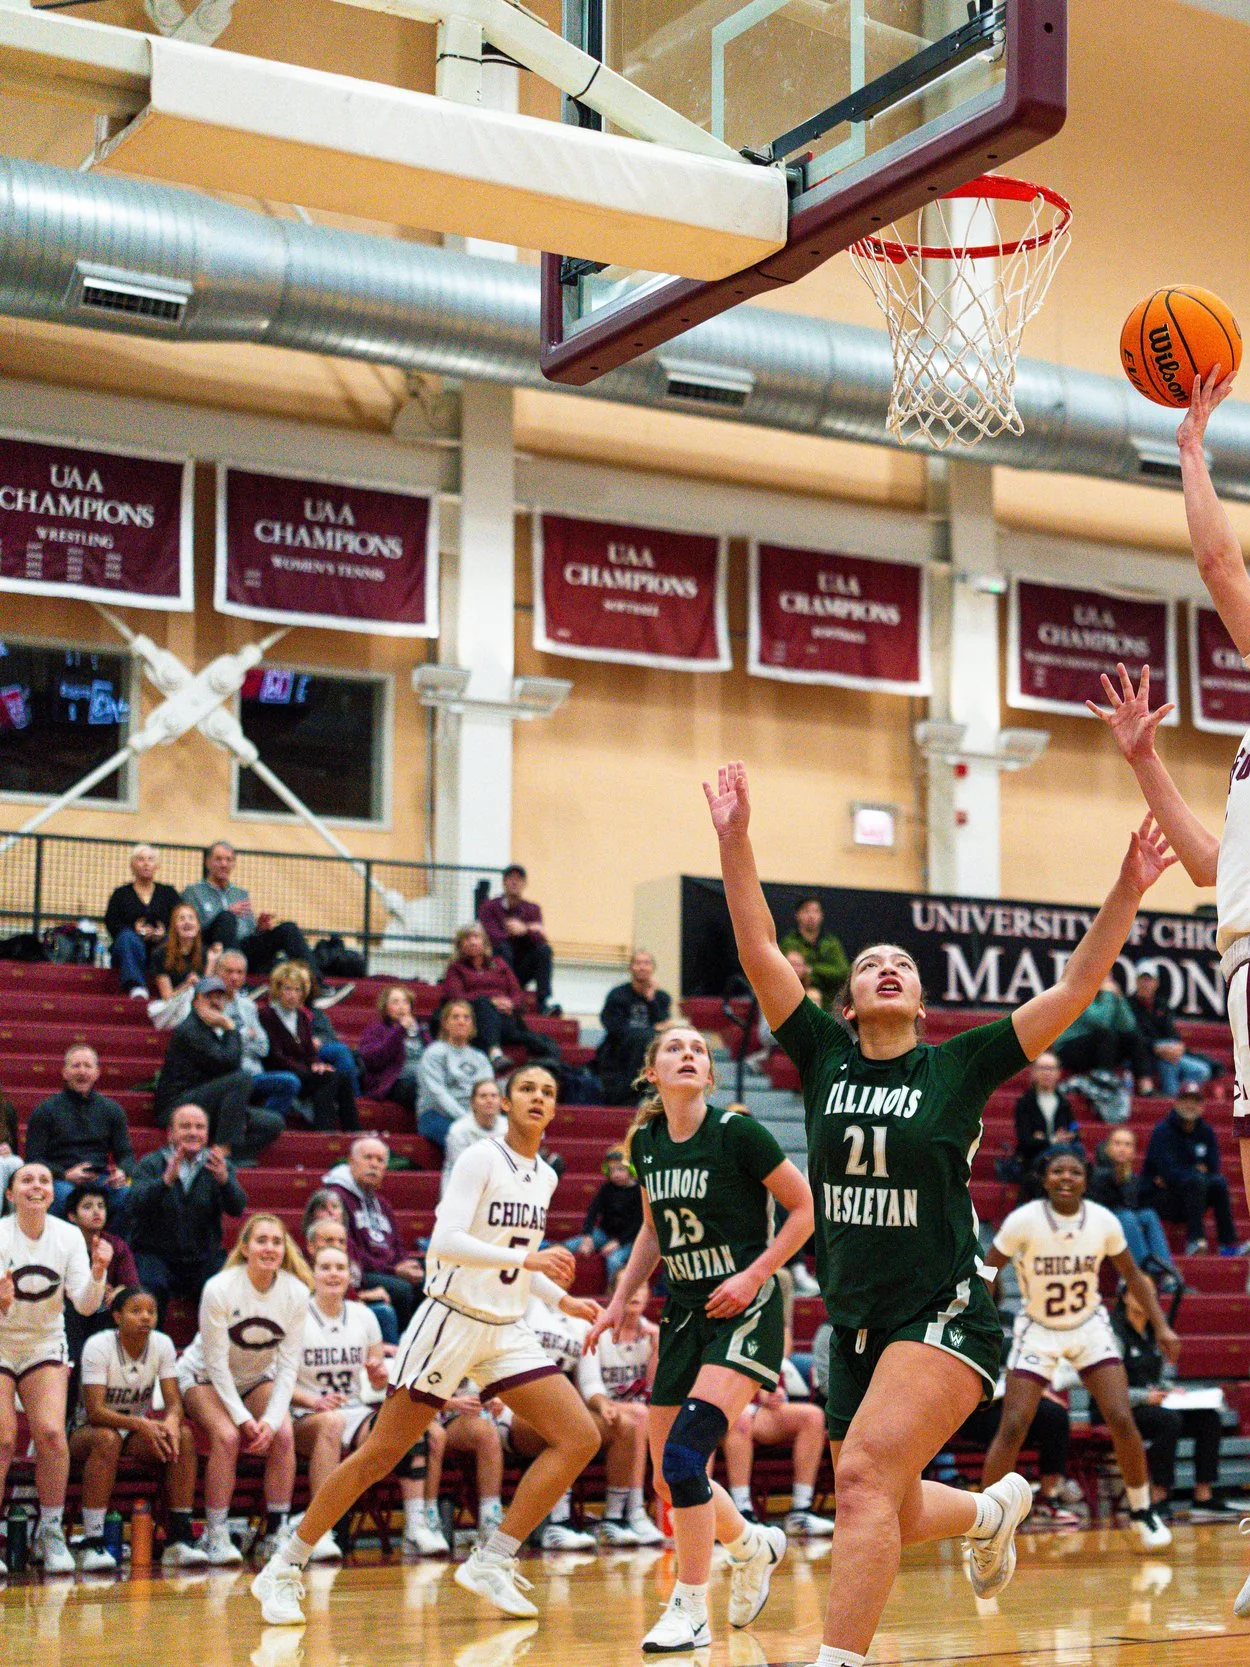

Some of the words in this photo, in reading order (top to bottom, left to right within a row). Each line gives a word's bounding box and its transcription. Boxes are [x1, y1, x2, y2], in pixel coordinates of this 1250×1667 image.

[1148, 323, 1189, 402] Wilson
[50, 463, 104, 494] UAA
[0, 485, 155, 529] CHAMPIONS
[304, 497, 356, 527] UAA
[35, 525, 115, 550] WRESTLING
[253, 518, 404, 560] CHAMPIONS
[607, 541, 655, 569] UAA
[563, 561, 699, 600] CHAMPIONS
[824, 1080, 923, 1119] ILLINOIS
[842, 1125, 890, 1179] 21
[645, 1168, 709, 1204] ILLINOIS
[664, 1207, 705, 1249] 23
[499, 1236, 531, 1286] 5
[1044, 1281, 1087, 1317] 23
